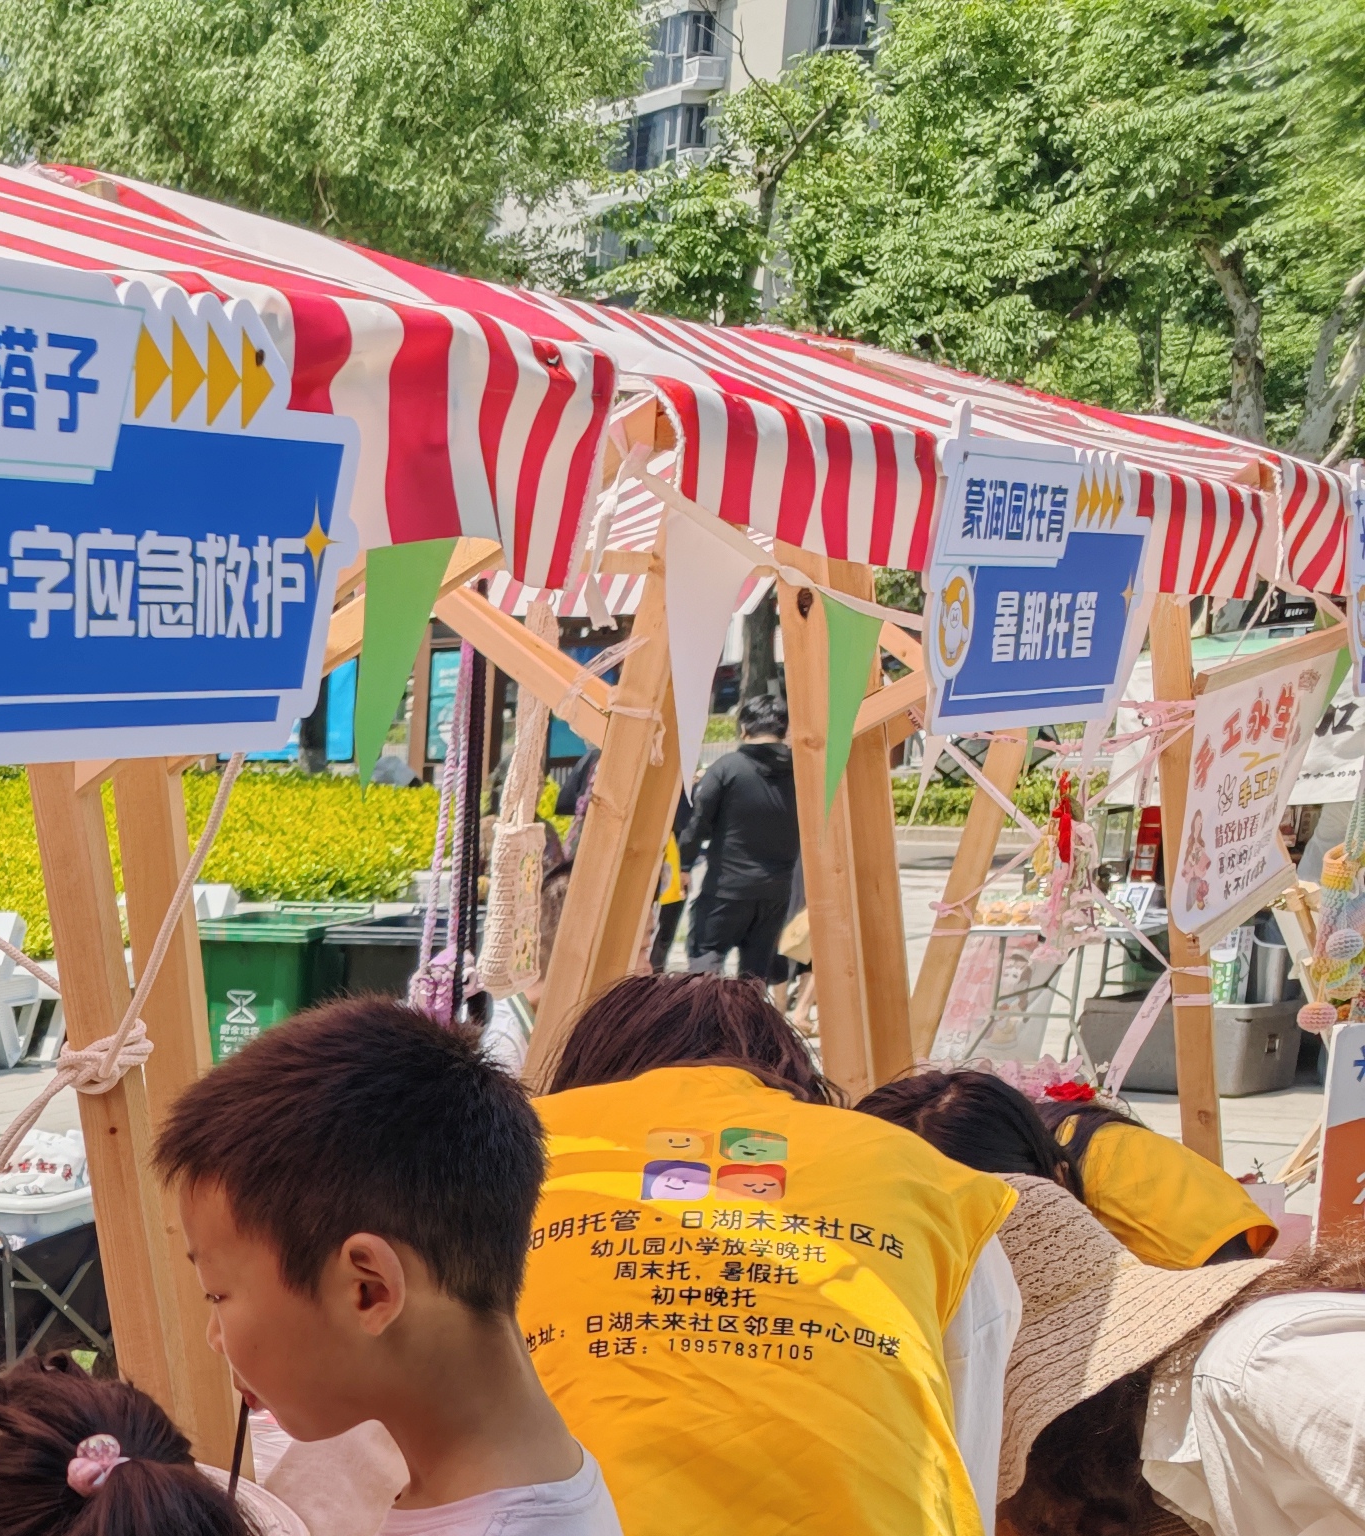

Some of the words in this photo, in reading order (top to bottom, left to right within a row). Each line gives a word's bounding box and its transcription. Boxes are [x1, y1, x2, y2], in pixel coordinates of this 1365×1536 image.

[961, 477, 1069, 543] 蒙润园托育
[991, 591, 1099, 663] 暑期托管
[1193, 681, 1302, 792] 手工永生
[590, 1236, 827, 1264] 幼儿园小学放学晚托
[613, 1260, 800, 1286] 周末托，暑假托
[650, 1284, 757, 1309] 初中晚托
[586, 1311, 901, 1360] 日湖未来社区邻里中心四楼
[668, 1336, 814, 1361] 19957837105
